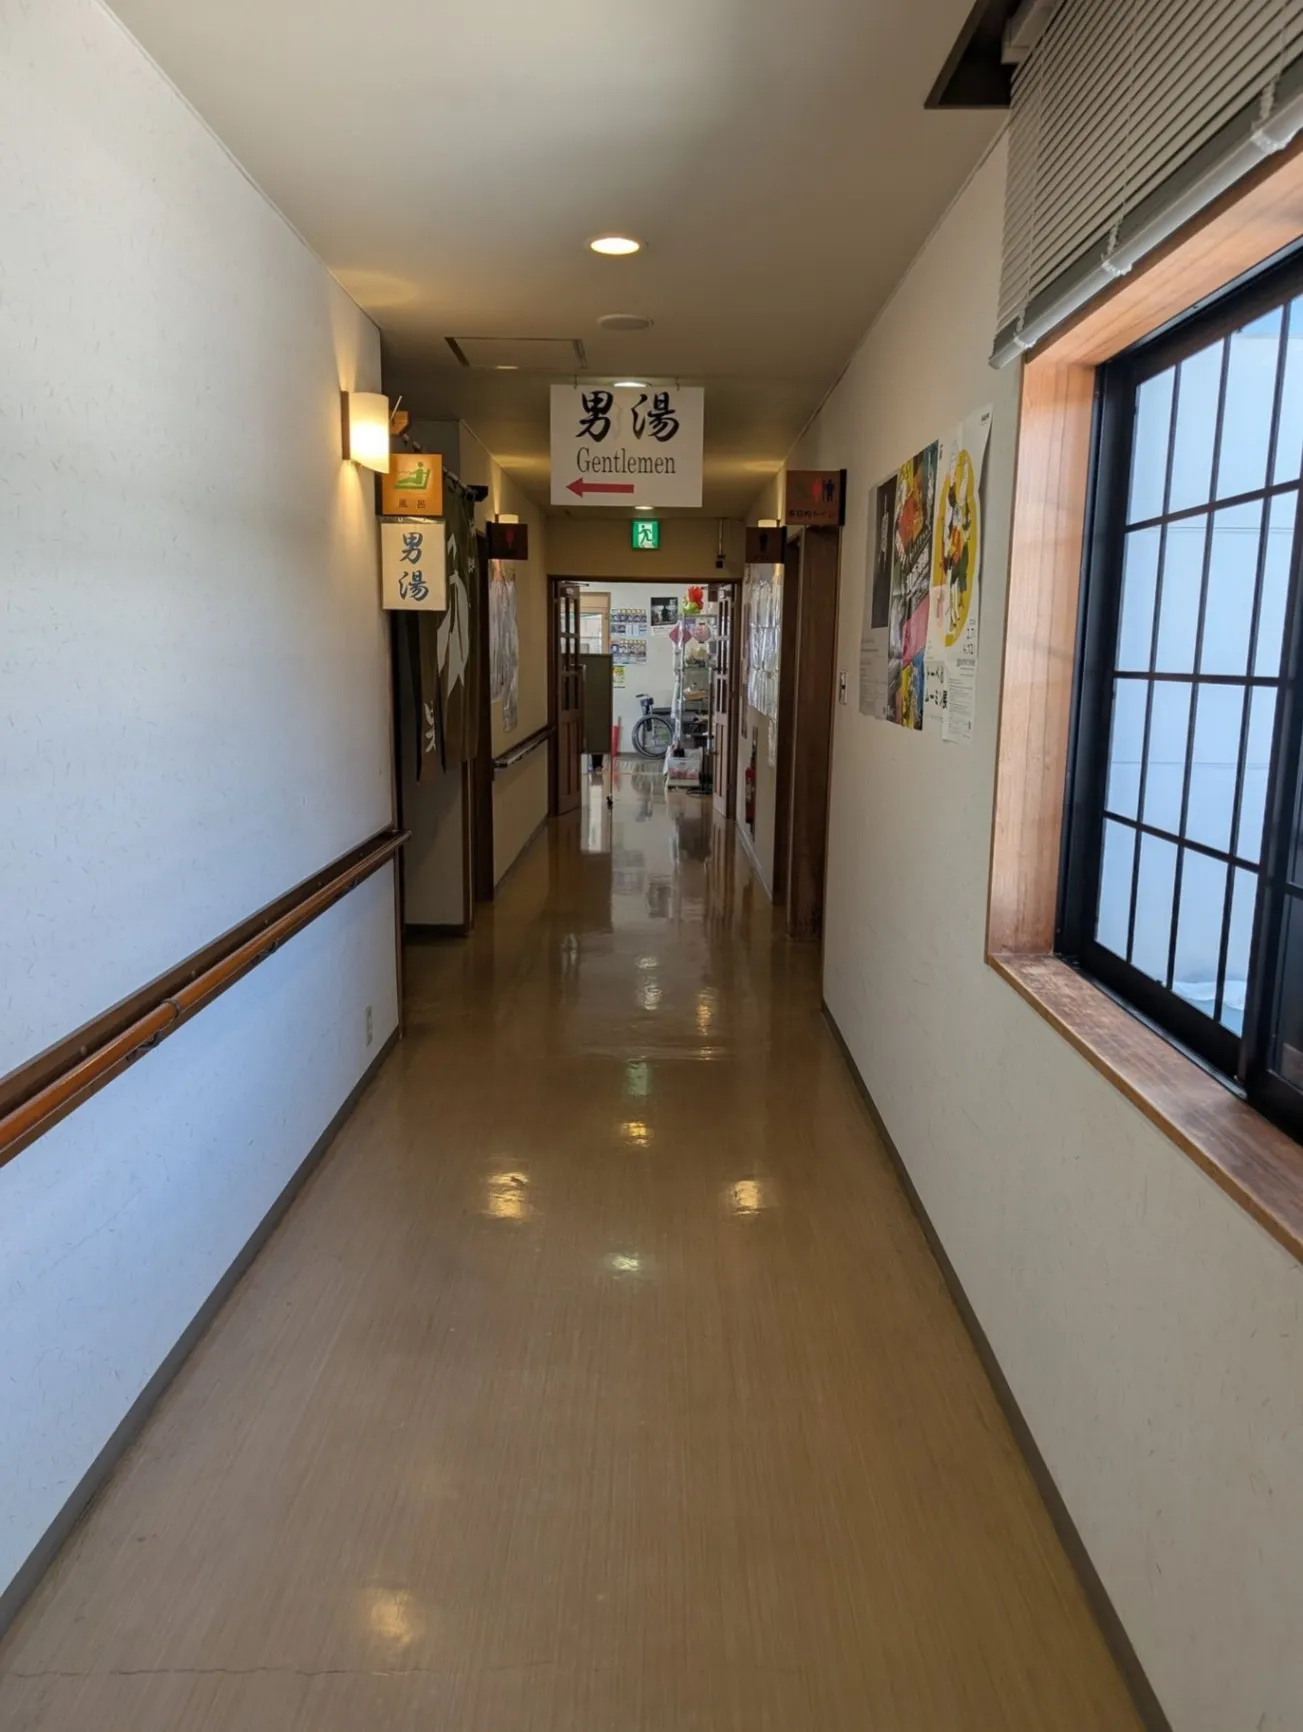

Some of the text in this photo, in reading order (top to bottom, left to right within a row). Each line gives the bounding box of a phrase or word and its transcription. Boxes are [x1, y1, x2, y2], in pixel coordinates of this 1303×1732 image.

[575, 389, 681, 443] 男湯
[576, 446, 676, 475] Gentlemen
[398, 531, 430, 602] 男湯
